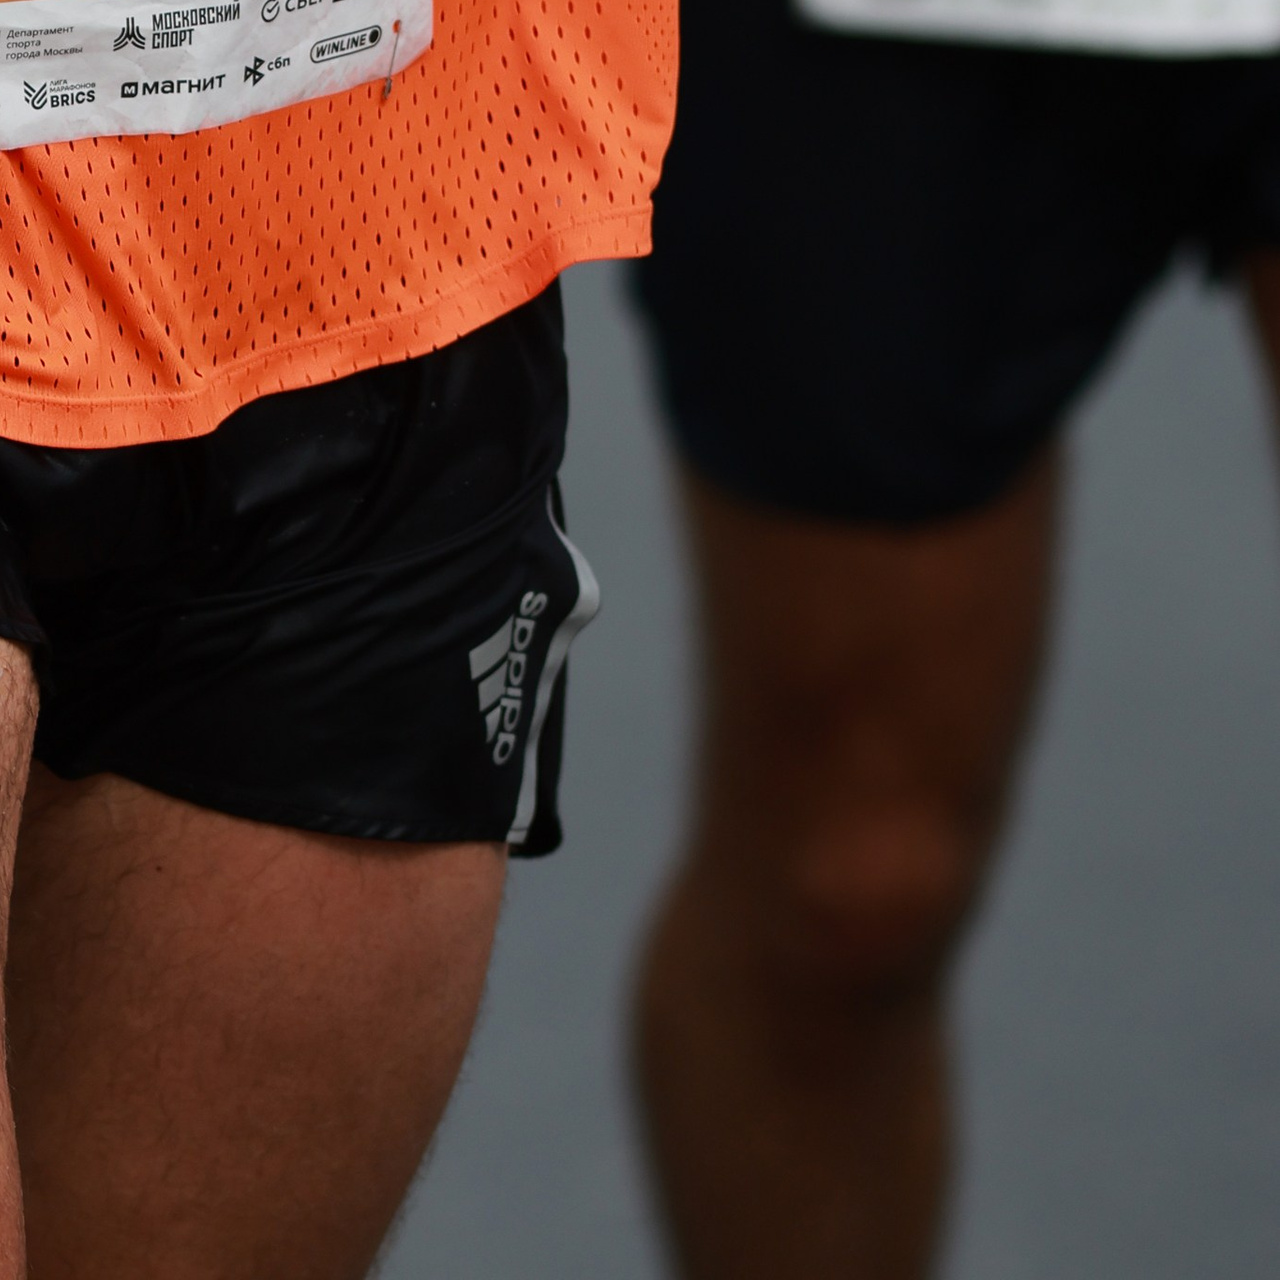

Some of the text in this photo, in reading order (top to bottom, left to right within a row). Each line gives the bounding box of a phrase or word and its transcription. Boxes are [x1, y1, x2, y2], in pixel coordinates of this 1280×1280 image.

[152, 0, 240, 31] МОСКОВСКИЙ
[6, 26, 74, 39] Департамент
[152, 28, 195, 50] СПОРТ
[6, 40, 41, 49] спорта
[315, 33, 367, 59] WINLINE
[6, 47, 83, 60] города Москвы
[267, 55, 291, 72] сбп
[50, 79, 68, 87] ЛИГА
[50, 82, 96, 93] МАРАФОНОВ
[142, 73, 226, 96] магнит
[50, 90, 96, 108] BRICS
[492, 591, 548, 766] adidas
